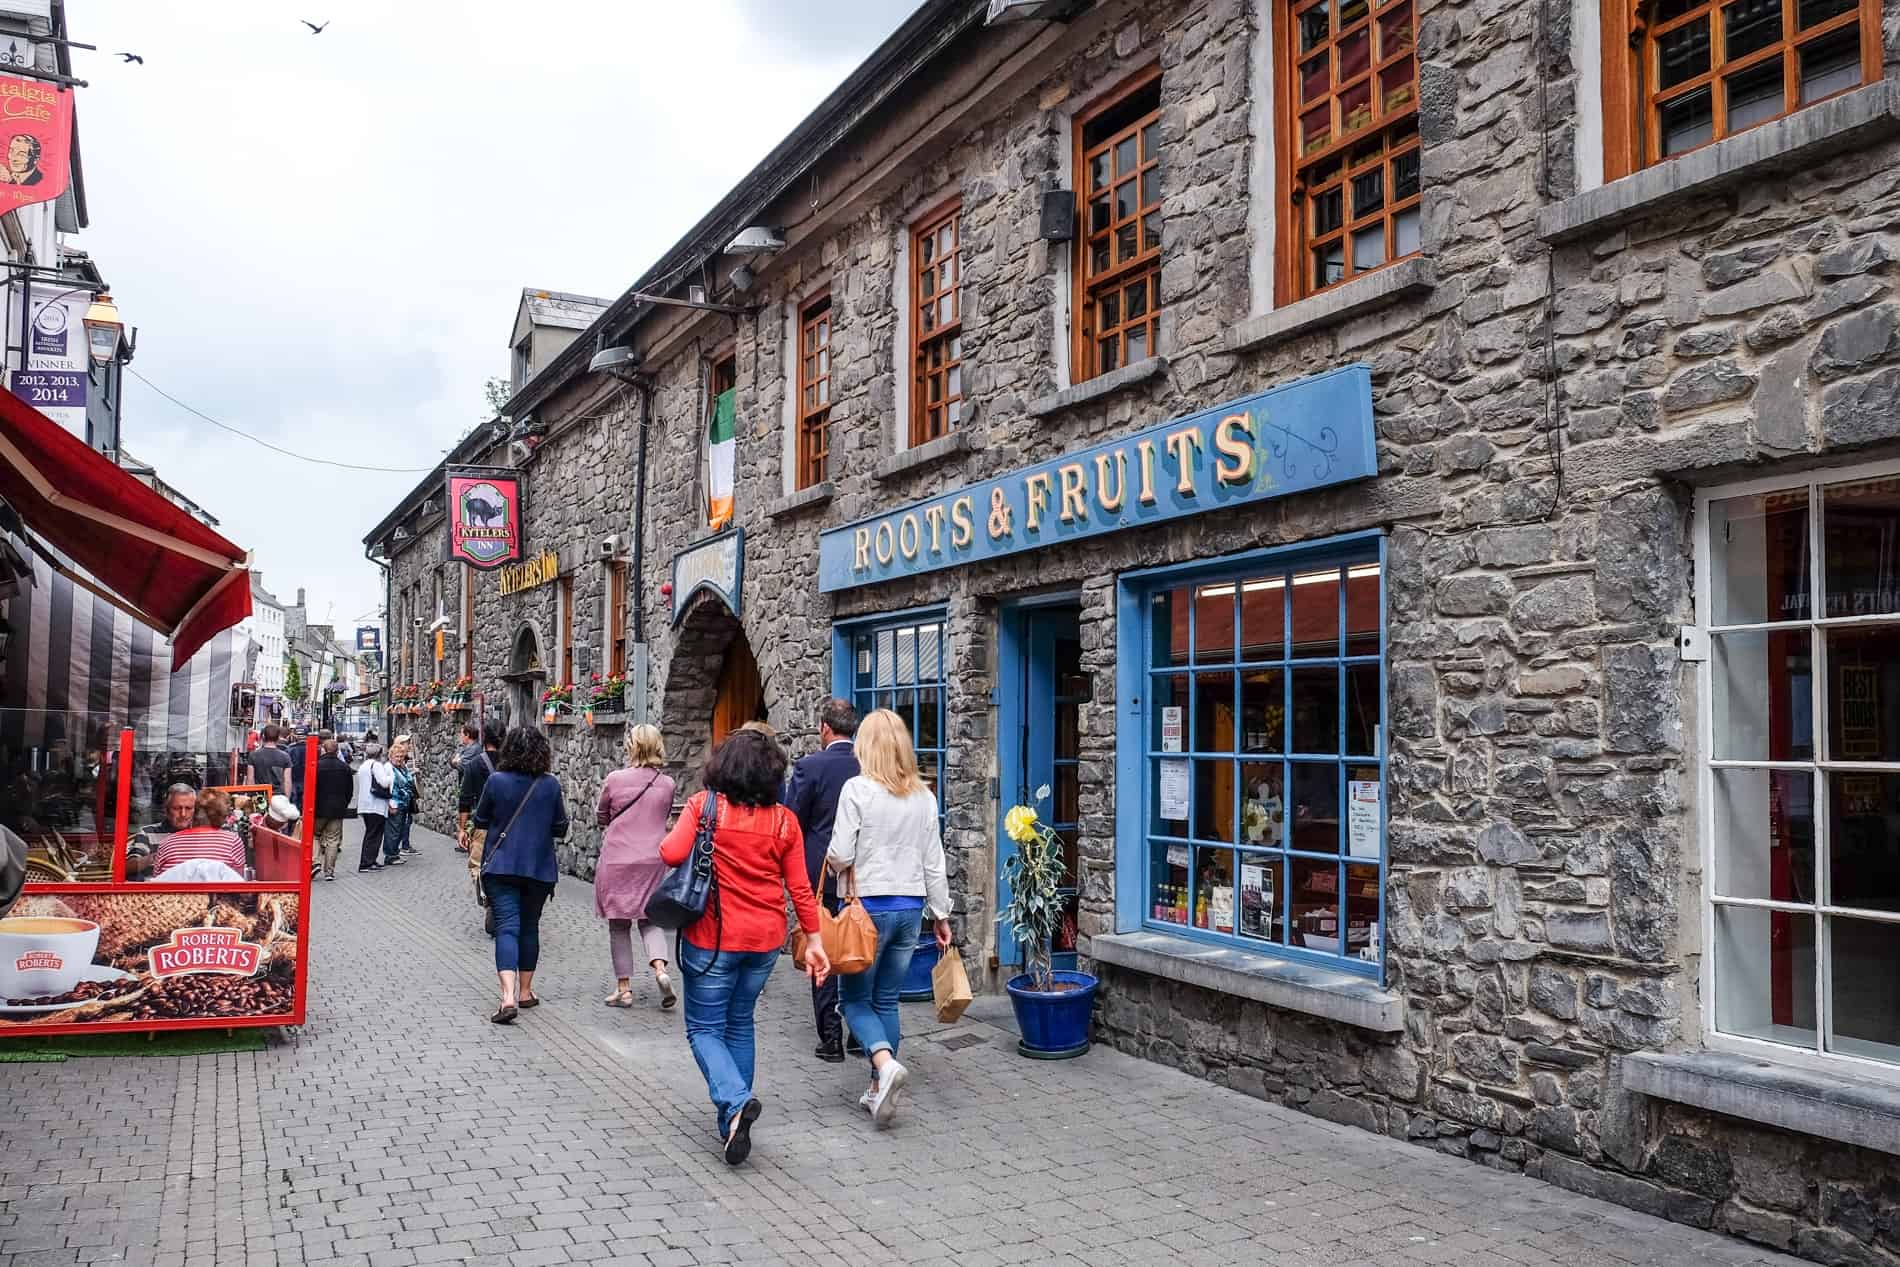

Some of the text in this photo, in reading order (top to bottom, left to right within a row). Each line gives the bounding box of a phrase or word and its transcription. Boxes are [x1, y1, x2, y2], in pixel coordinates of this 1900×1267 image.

[31, 388, 69, 401] 2014
[853, 411, 1254, 571] ROOTS & FRUITS
[461, 527, 511, 538] KYTELERS
[477, 541, 494, 550] INN
[181, 933, 233, 947] ROBERT
[19, 958, 61, 969] ROBERTS
[160, 948, 250, 969] ROBERTS
